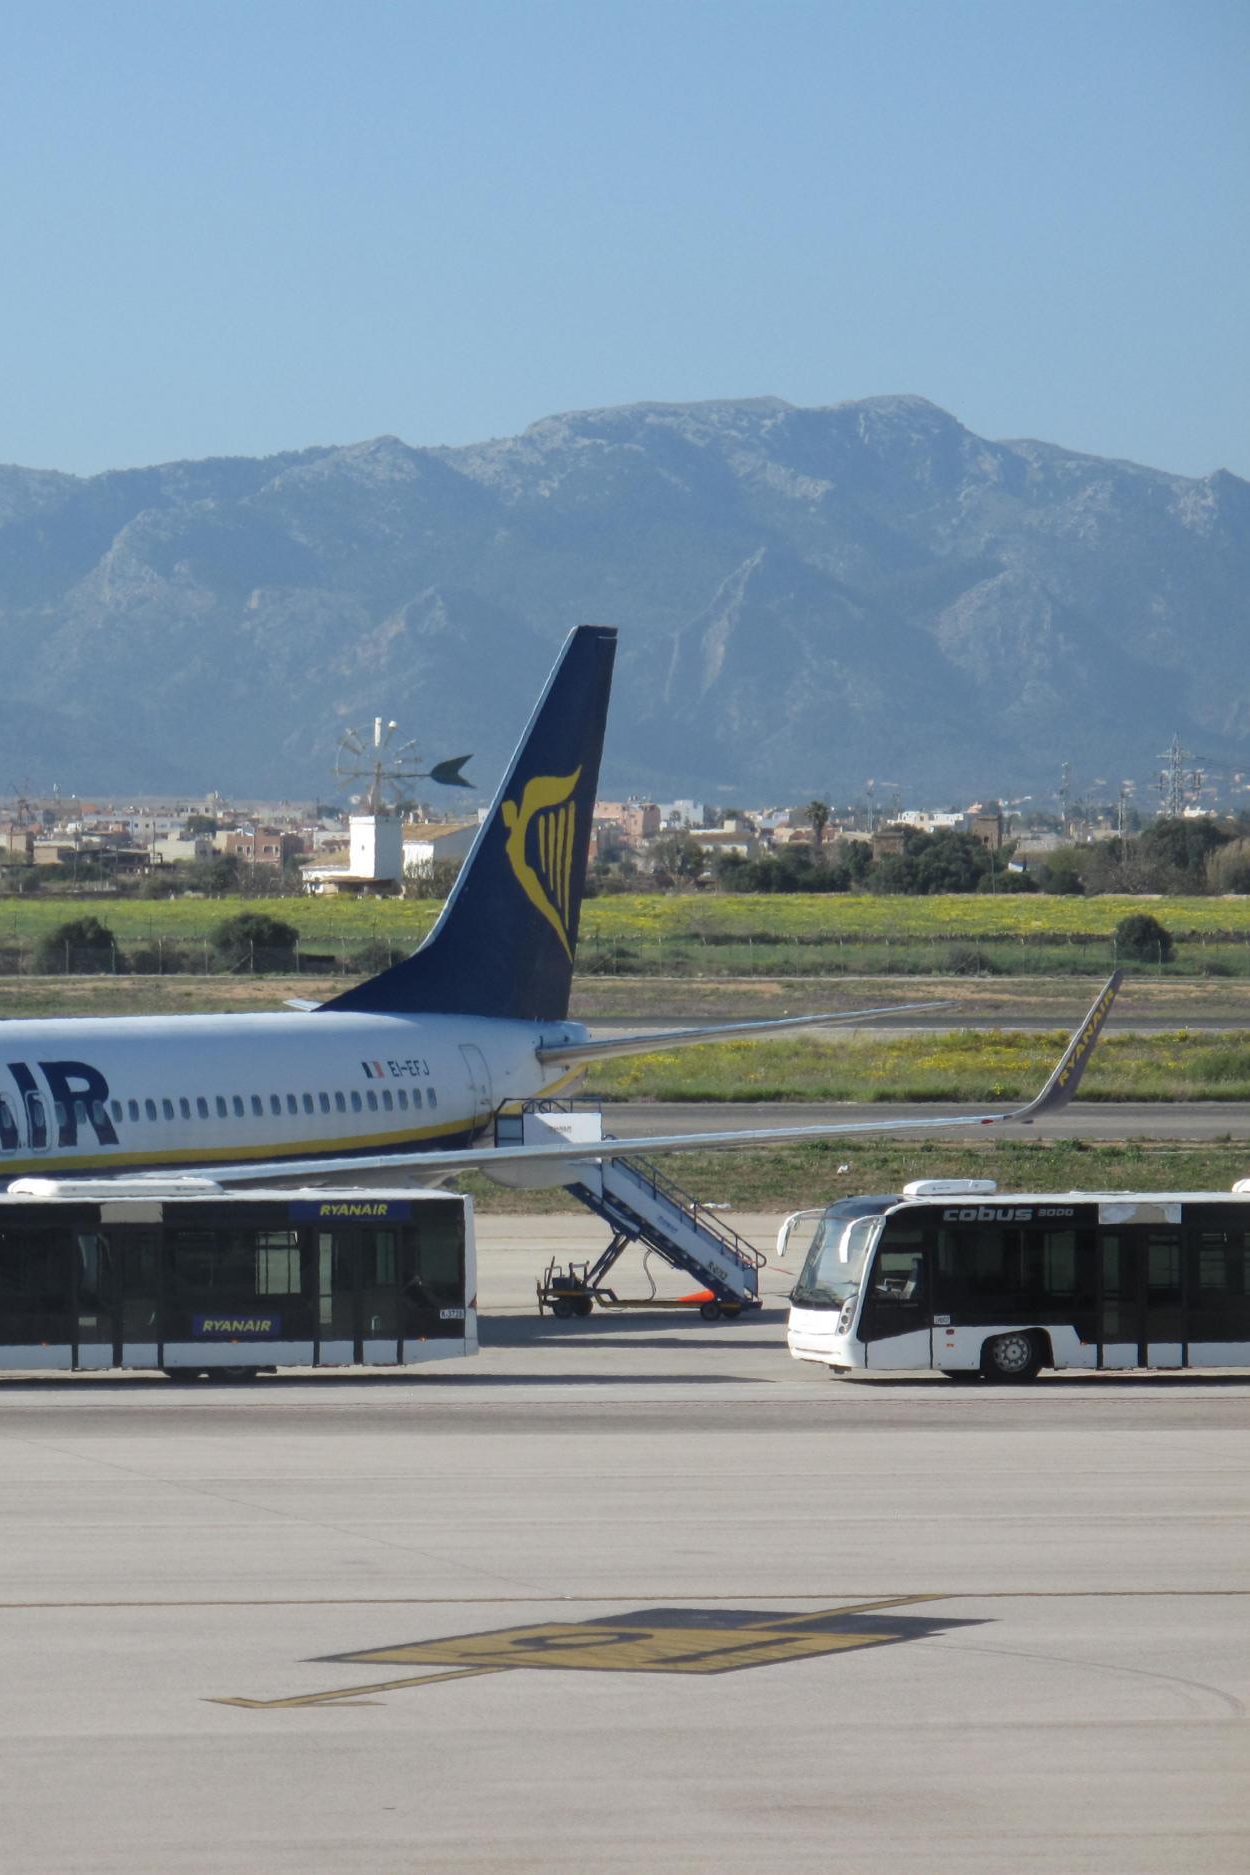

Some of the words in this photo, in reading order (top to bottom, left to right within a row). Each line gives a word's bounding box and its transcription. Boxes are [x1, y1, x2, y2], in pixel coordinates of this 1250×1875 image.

[1058, 987, 1115, 1088] RYANAIR
[387, 1060, 430, 1078] EI-EFJ
[319, 1203, 388, 1217] RYANAIR
[943, 1206, 1034, 1222] cobus
[1037, 1208, 1075, 1217] 3000
[202, 1320, 272, 1332] RYANAIR
